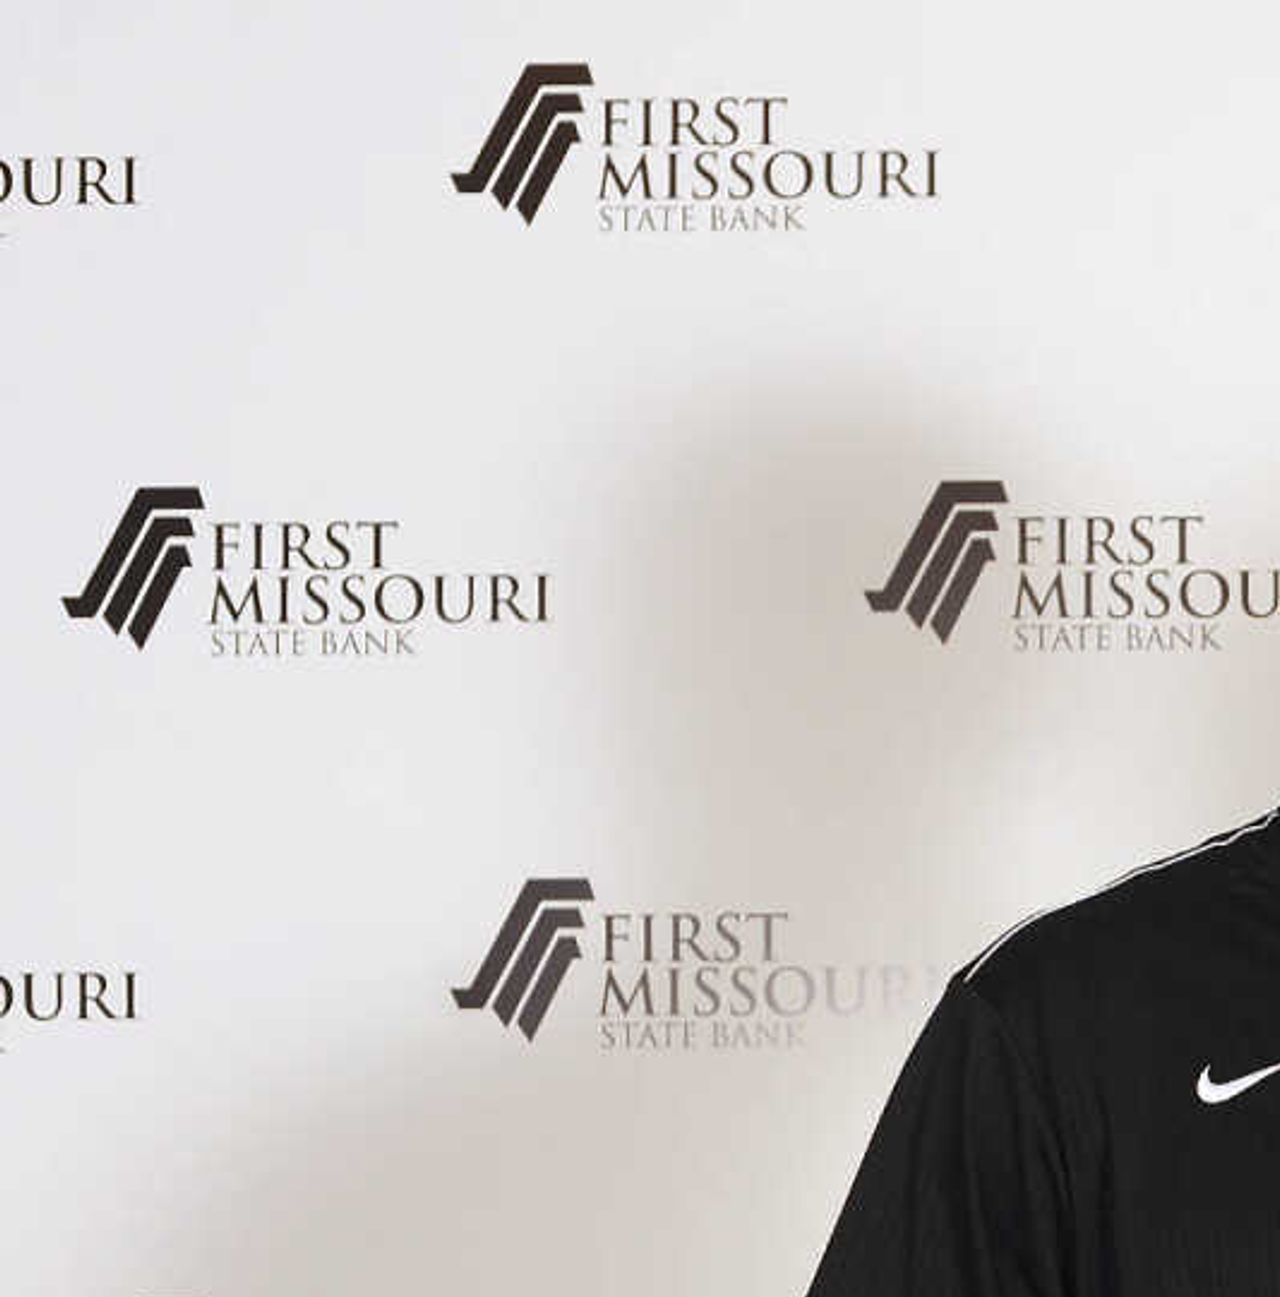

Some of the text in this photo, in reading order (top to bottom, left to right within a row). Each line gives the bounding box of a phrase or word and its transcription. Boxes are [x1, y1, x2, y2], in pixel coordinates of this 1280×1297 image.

[600, 96, 788, 148] FIRST
[597, 149, 938, 201] MISSOURI
[598, 205, 806, 232] STATE BANK
[211, 520, 399, 572] FIRST
[1015, 516, 1203, 568] FIRST
[208, 573, 549, 625] MISSOURI
[209, 629, 417, 656] STATE BANK
[1013, 625, 1221, 652] STATE BANK
[601, 911, 789, 963] FIRST
[599, 1020, 807, 1047] STATE BANK
